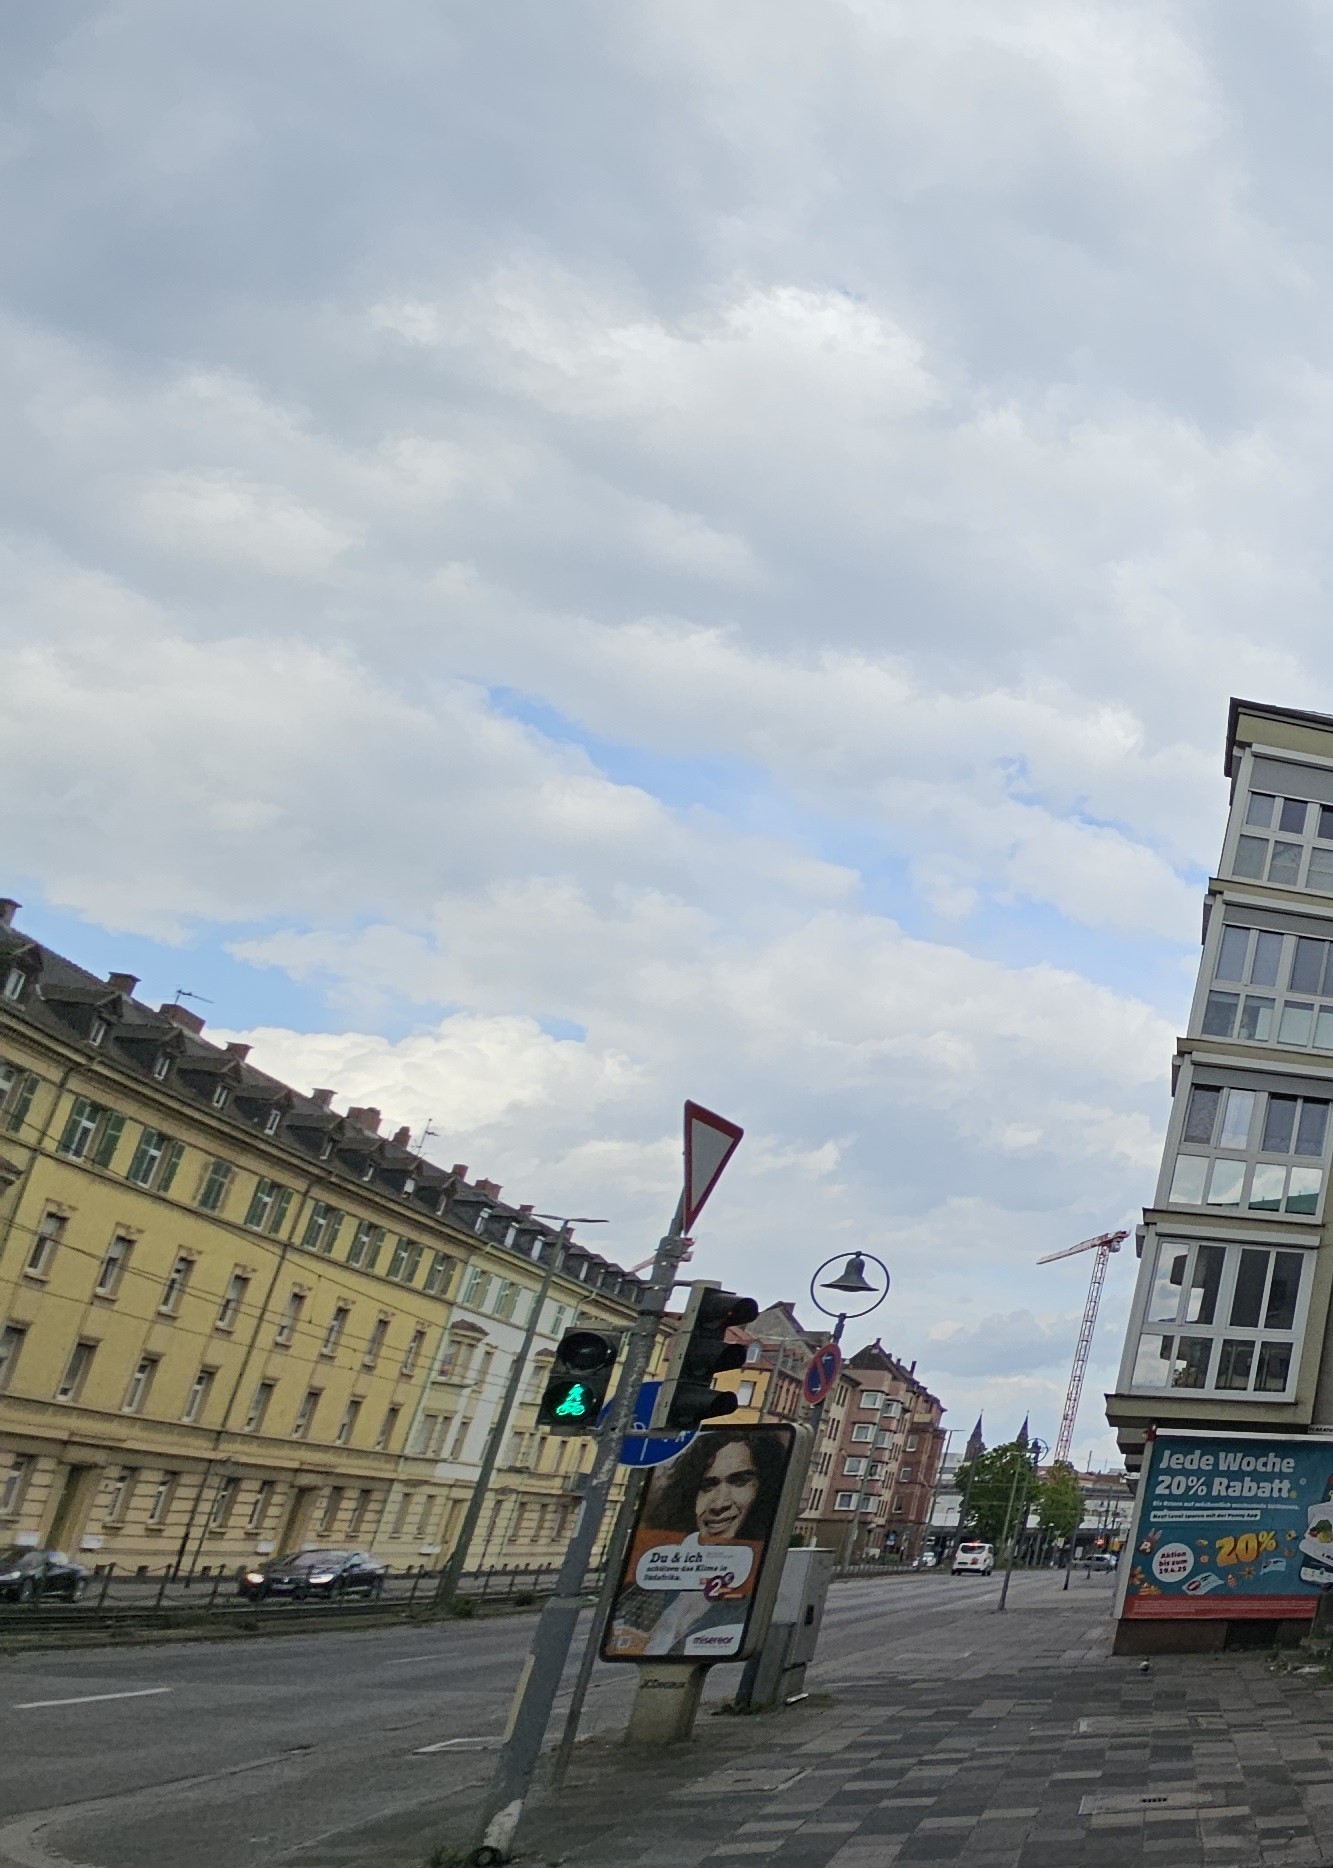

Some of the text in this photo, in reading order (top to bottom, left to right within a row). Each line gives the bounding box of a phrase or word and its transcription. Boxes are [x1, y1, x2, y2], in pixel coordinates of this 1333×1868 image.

[1159, 1450, 1295, 1473] Jede Woche
[1155, 1475, 1297, 1498] 20% Rabatt.
[1215, 1530, 1277, 1568] 20%
[650, 1552, 668, 1563] Du
[671, 1552, 681, 1563] &
[684, 1552, 702, 1563] ich
[1160, 1551, 1186, 1559] Aktion
[1172, 1558, 1188, 1566] zum
[694, 1636, 734, 1645] misereor
